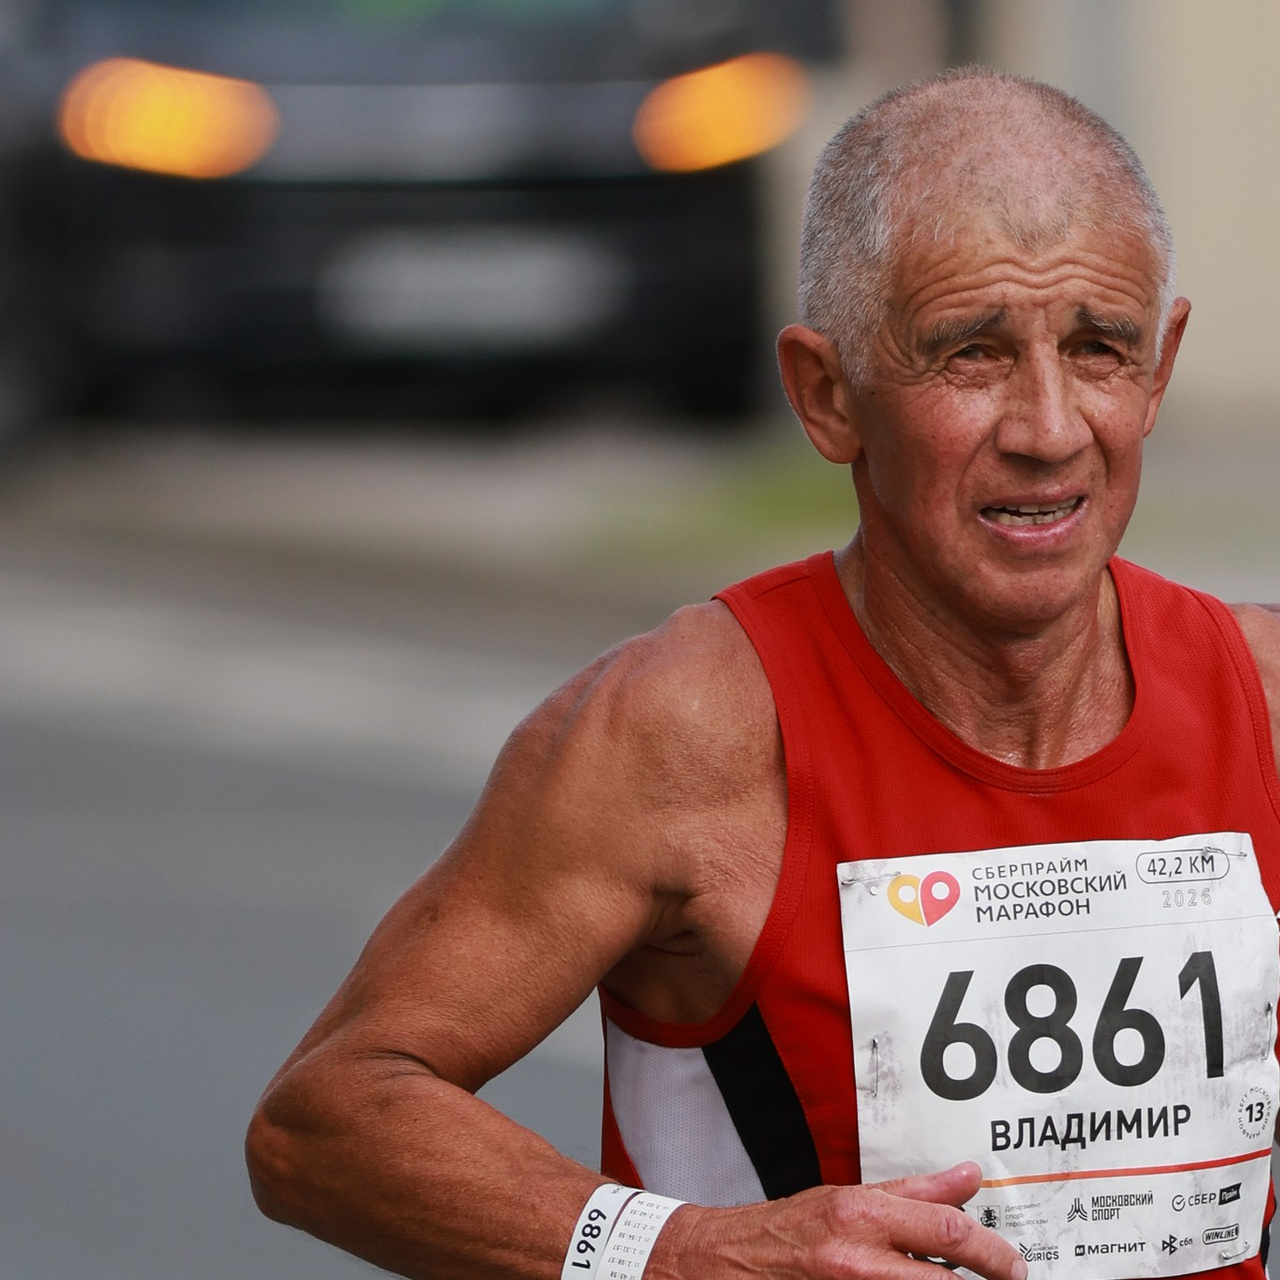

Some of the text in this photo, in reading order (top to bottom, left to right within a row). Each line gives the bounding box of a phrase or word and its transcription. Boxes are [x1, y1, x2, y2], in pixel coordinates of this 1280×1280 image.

[971, 858, 1088, 880] СБЕРПРАЙМ
[1147, 855, 1215, 878] 42,2 КМ
[973, 870, 1128, 902] МОСКОВСКИЙ
[1162, 888, 1212, 908] 2026
[975, 898, 1091, 923] МАРАФОН
[919, 950, 1224, 1101] 6861
[1245, 1101, 1265, 1123] 13
[990, 1103, 1192, 1152] ВЛАДИМИР
[1091, 1190, 1154, 1208] МОСКОВСКИЙ
[1188, 1193, 1217, 1206] СБЕР
[1091, 1208, 1121, 1221] СПОРТ
[571, 1208, 607, 1270] 6861
[1179, 1237, 1193, 1247] сбп
[1204, 1229, 1235, 1242] WINLINE
[1087, 1241, 1147, 1256] магнит
